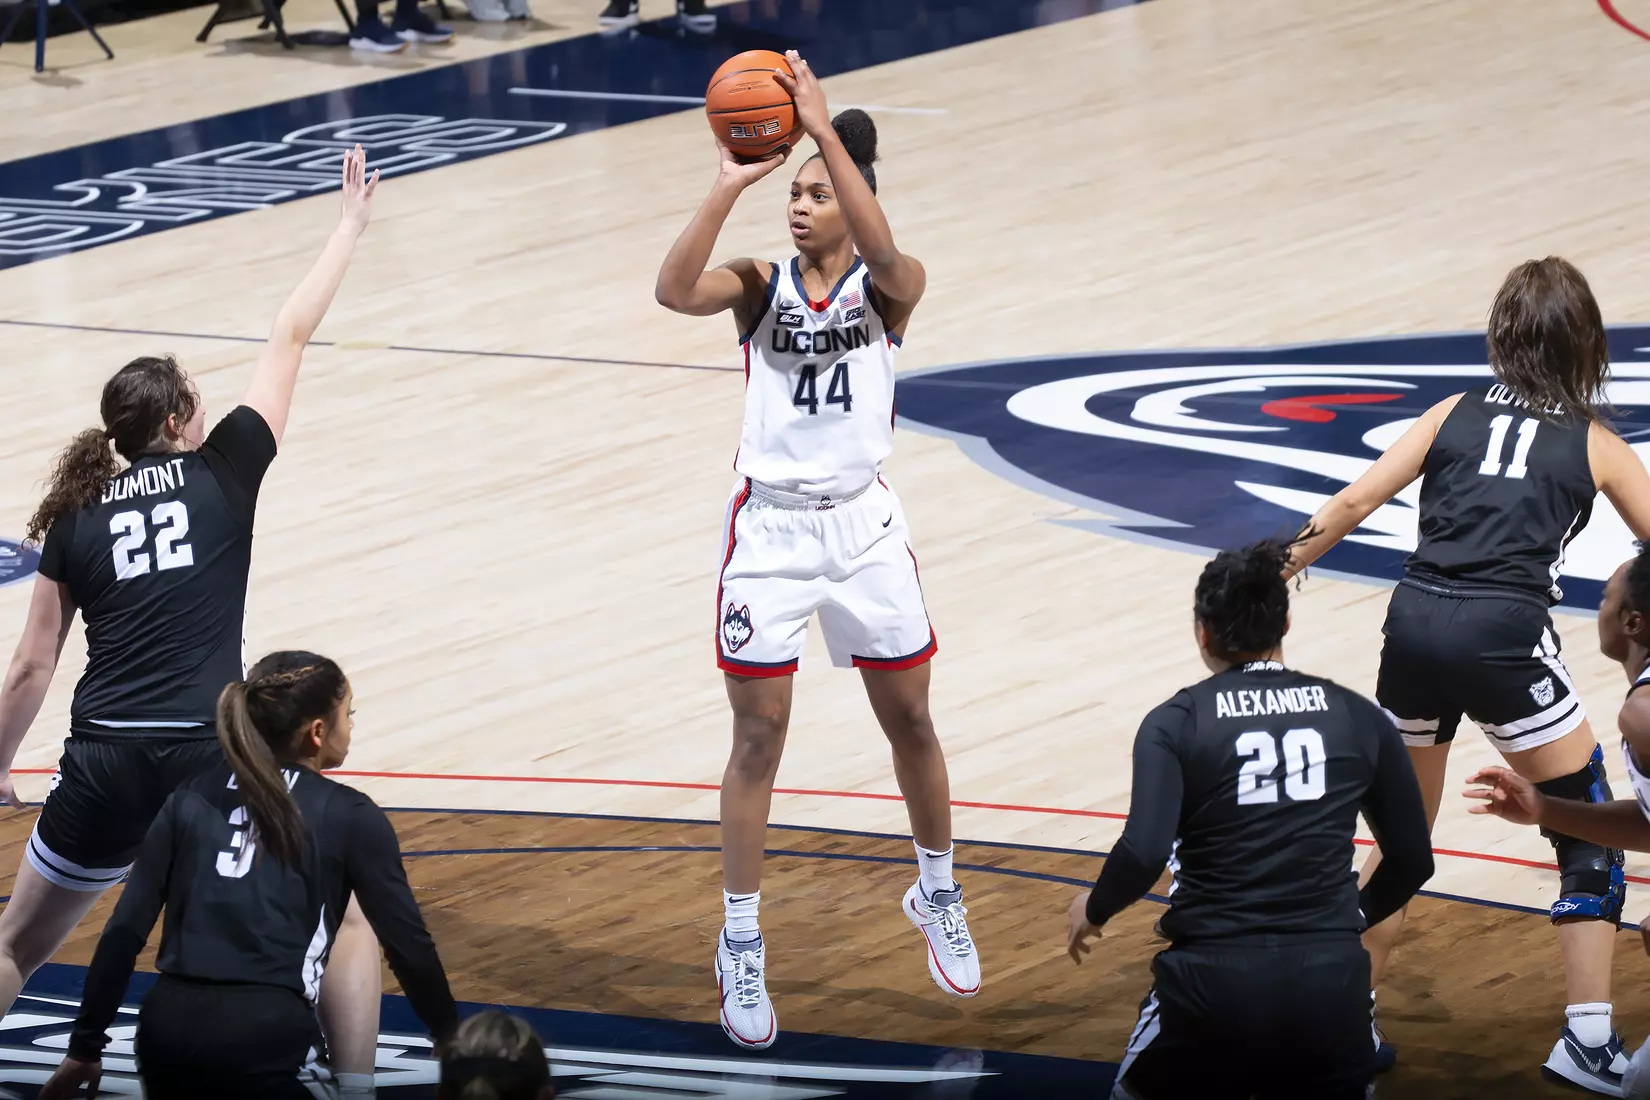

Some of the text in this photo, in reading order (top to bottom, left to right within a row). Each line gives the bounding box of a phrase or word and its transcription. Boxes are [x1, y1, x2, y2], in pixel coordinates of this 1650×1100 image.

[730, 120, 782, 138] ELITE
[771, 324, 870, 354] UCONN
[794, 362, 853, 415] 44
[1478, 414, 1540, 479] 11
[101, 458, 185, 504] DUMONT
[815, 503, 836, 511] UCONN
[109, 500, 194, 580] 22
[1216, 685, 1329, 719] ALEXANDER
[1236, 728, 1327, 805] 20
[216, 806, 256, 879] 3
